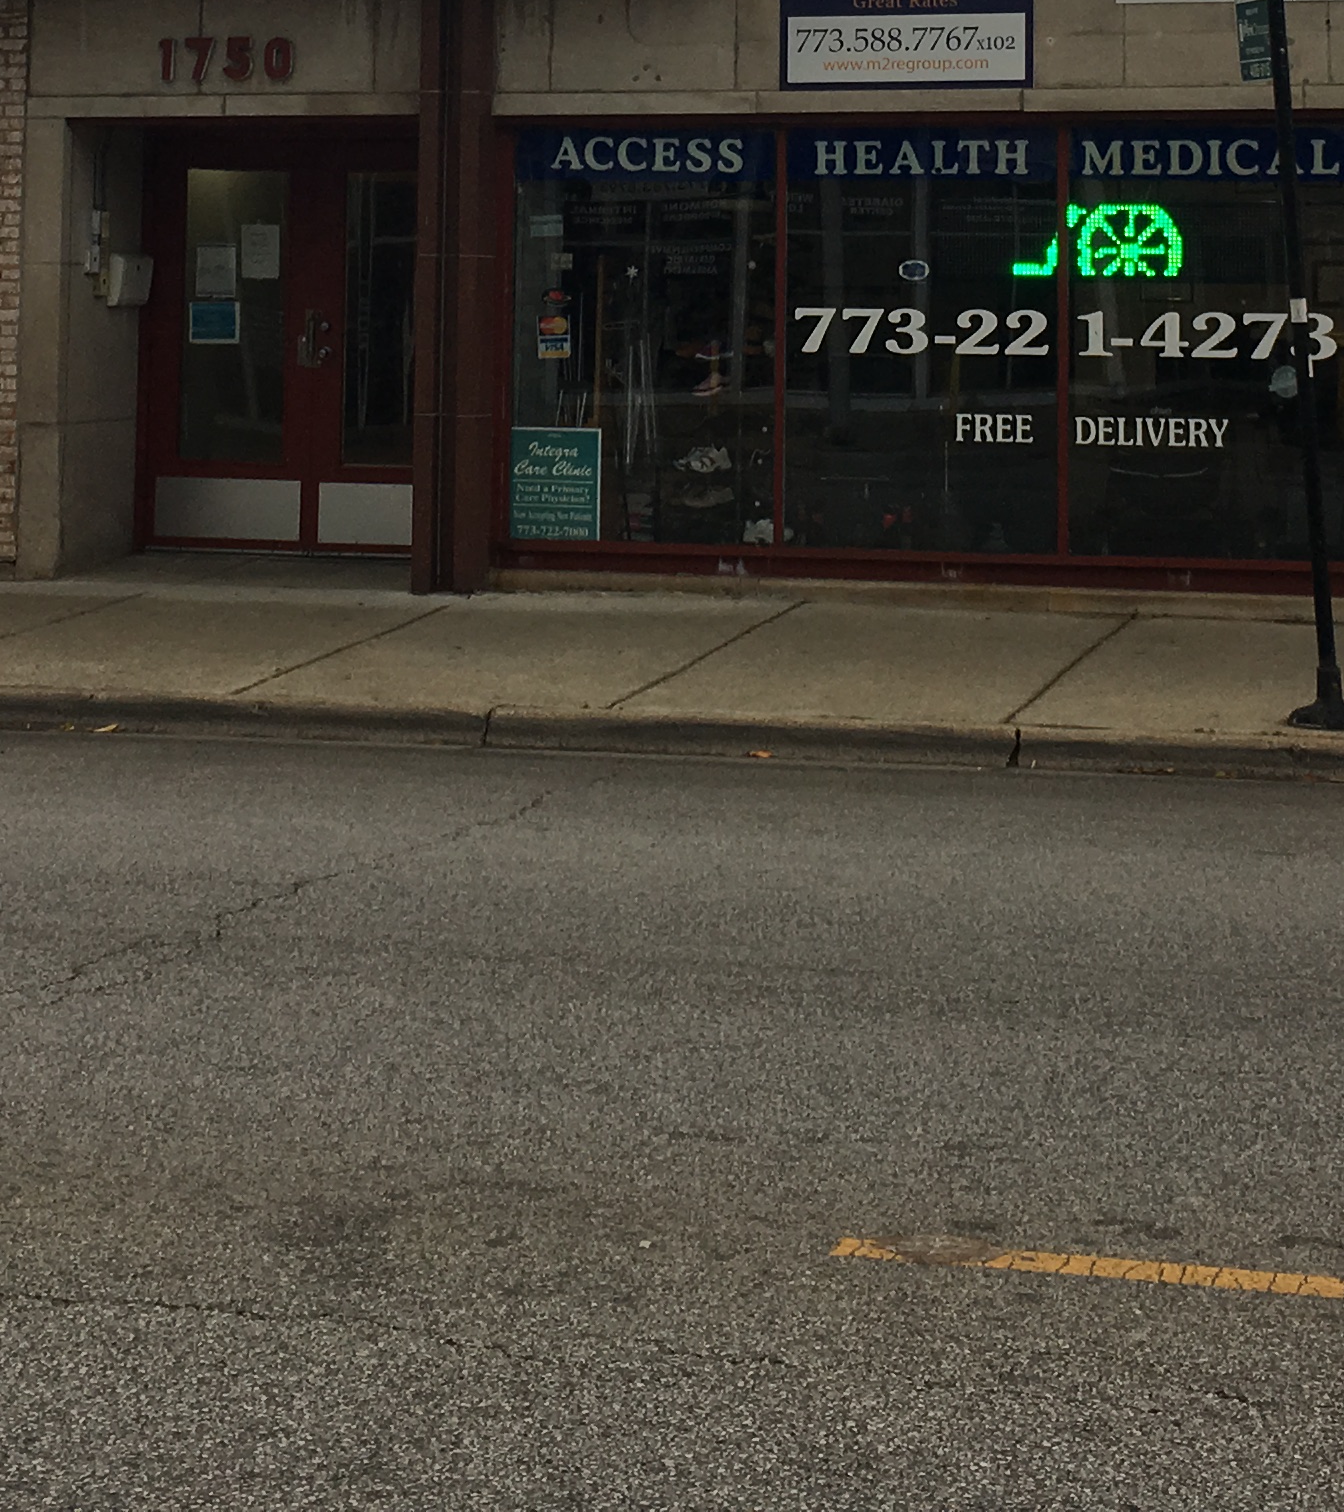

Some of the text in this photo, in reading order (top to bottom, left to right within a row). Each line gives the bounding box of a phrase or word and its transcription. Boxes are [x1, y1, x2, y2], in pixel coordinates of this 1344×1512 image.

[158, 36, 295, 84] 1750
[822, 57, 989, 73] www.m2regroup.com
[551, 136, 744, 173] ACCESS
[814, 139, 1029, 176] HEALTH
[955, 414, 1229, 448] FREE DELIVERY
[528, 441, 579, 462] Integra
[514, 459, 592, 476] Care Clinic
